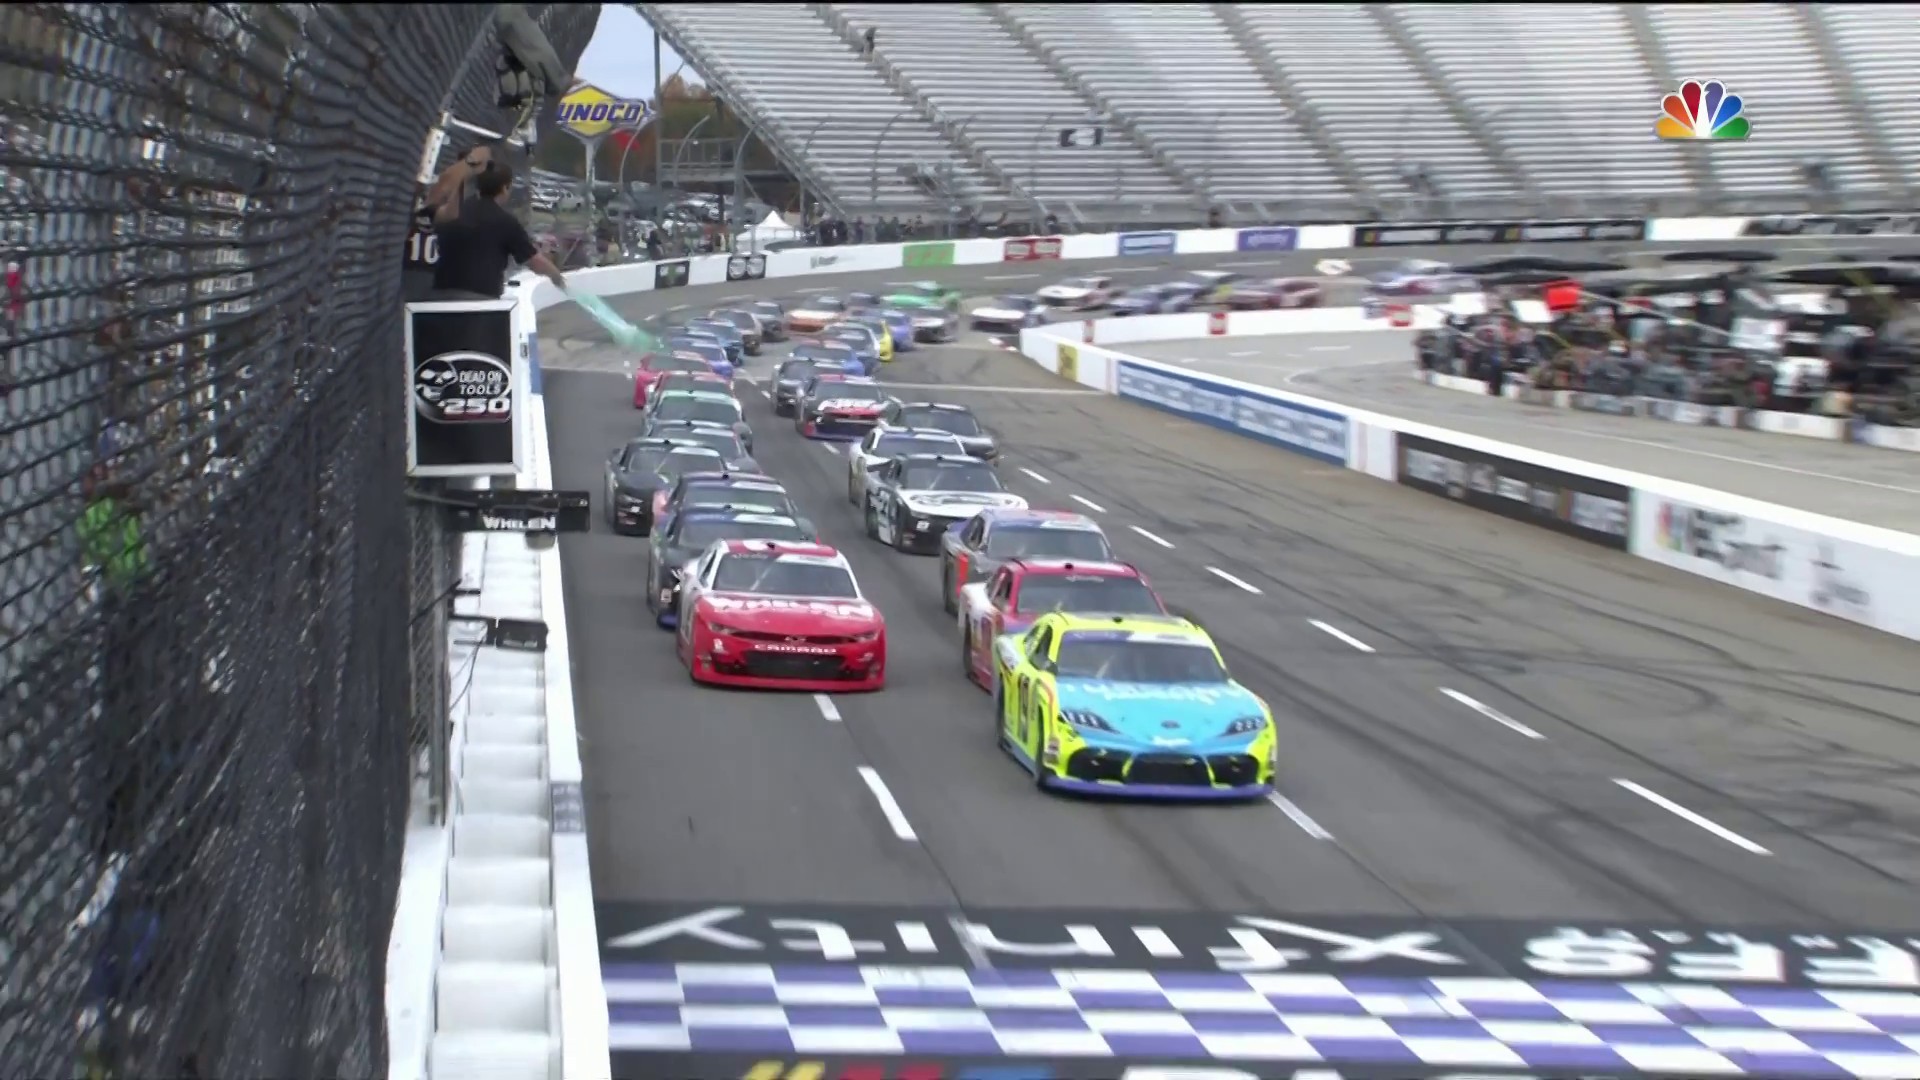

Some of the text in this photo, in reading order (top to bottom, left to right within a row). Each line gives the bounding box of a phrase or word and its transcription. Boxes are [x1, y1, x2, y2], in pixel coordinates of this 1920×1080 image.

[556, 103, 642, 121] UNOCO
[460, 371, 502, 383] DEAD ON
[460, 384, 501, 395] TOOLS
[482, 515, 556, 529] WHELEN
